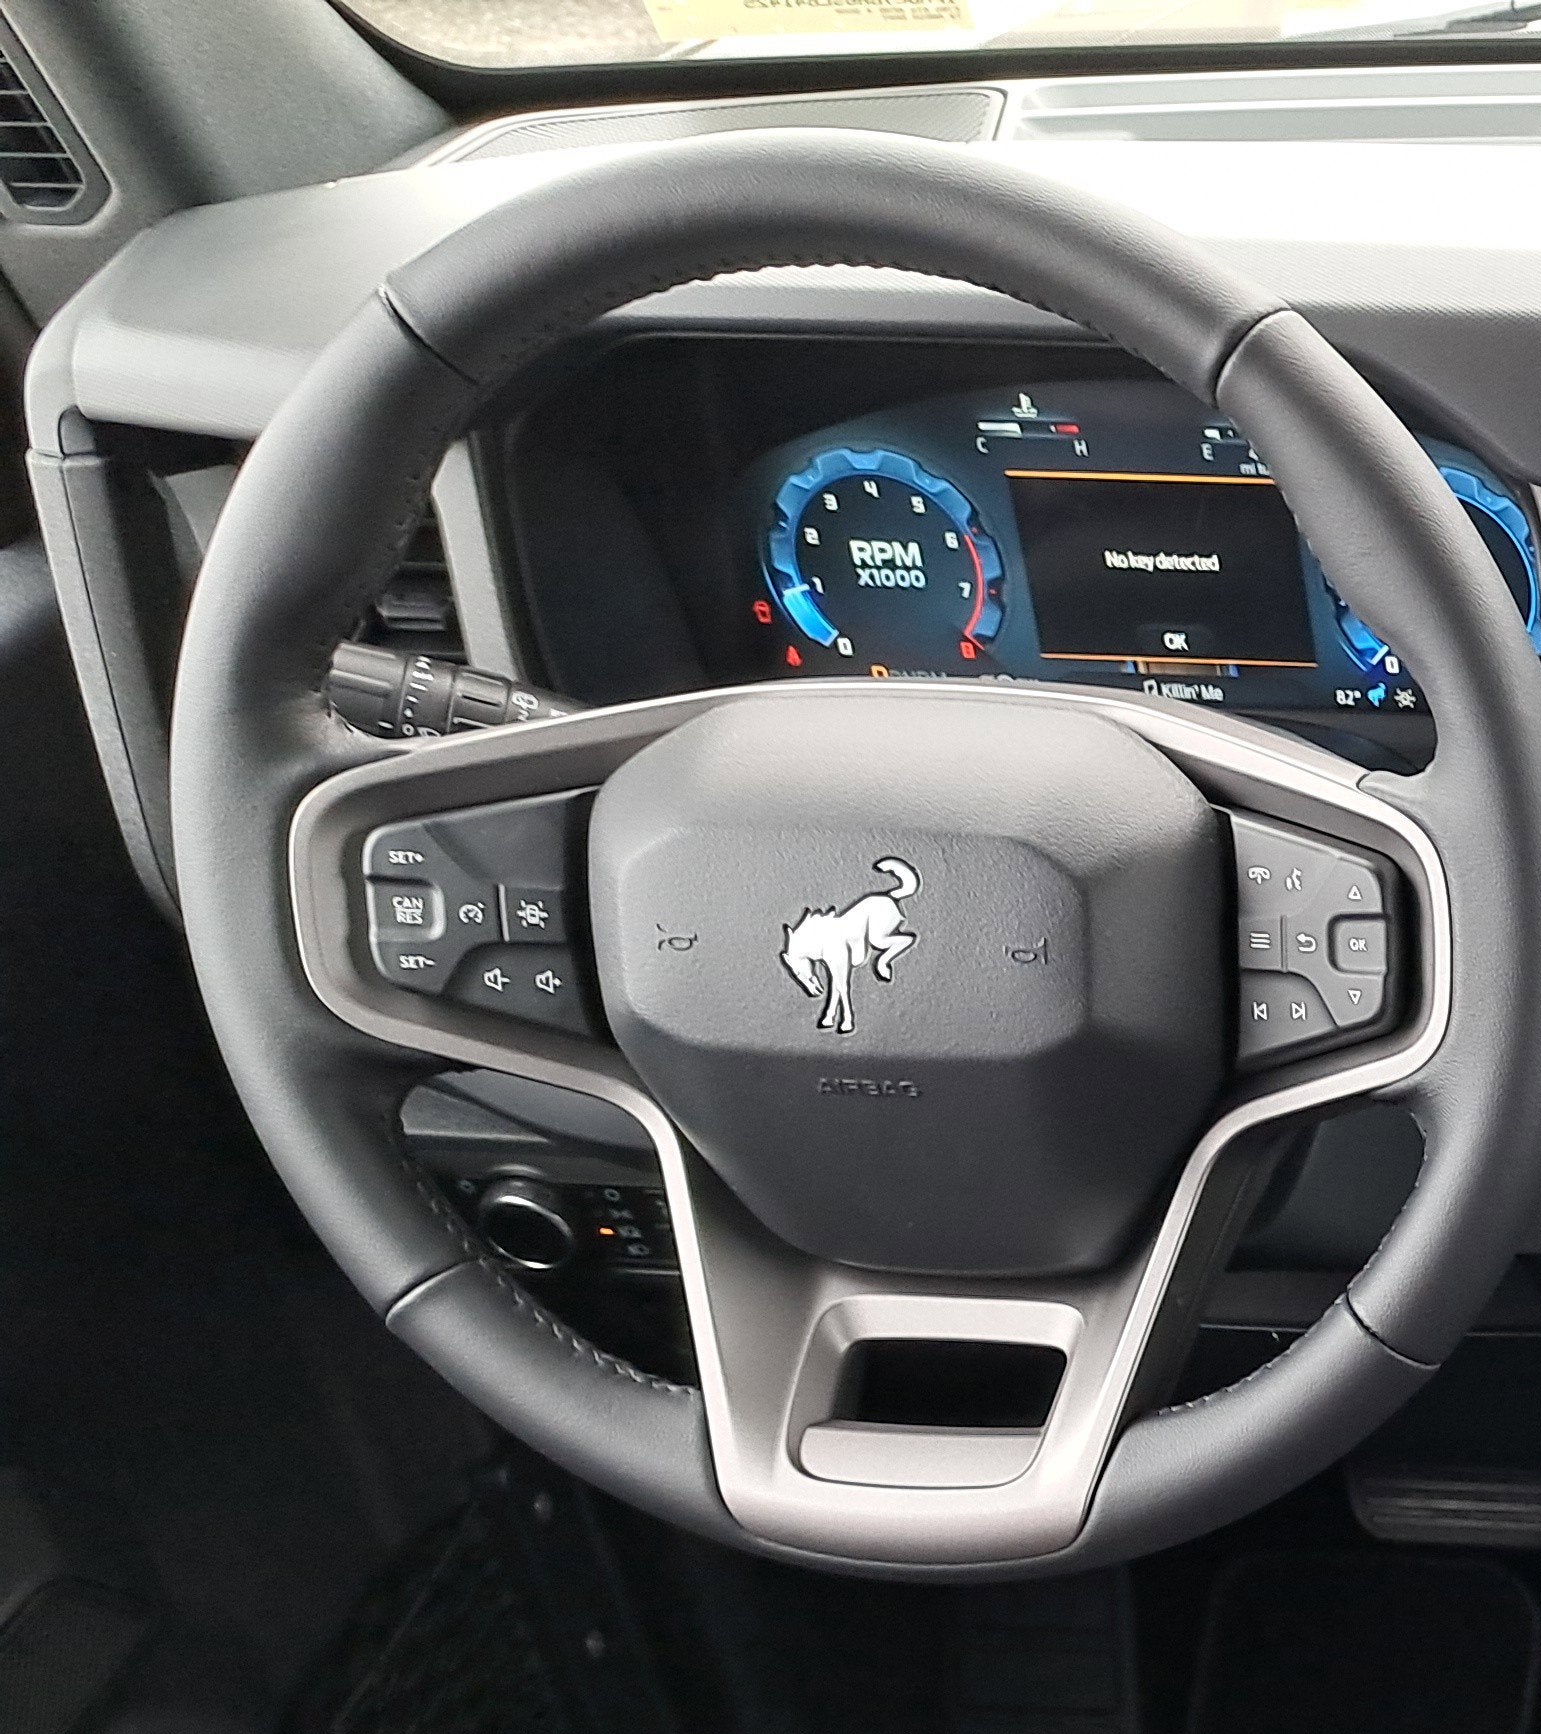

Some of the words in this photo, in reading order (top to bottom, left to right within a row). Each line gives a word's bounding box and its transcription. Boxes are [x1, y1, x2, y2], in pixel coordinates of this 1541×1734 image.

[976, 436, 989, 454] C
[1073, 439, 1089, 457] H
[1201, 443, 1214, 461] E
[862, 480, 880, 498] 4
[822, 493, 839, 511] 3
[910, 496, 926, 514] 5
[804, 527, 821, 545] 2
[944, 531, 960, 549] 6
[849, 539, 923, 568] RPM
[1104, 550, 1129, 568] No
[1127, 551, 1154, 572] key
[1155, 551, 1220, 572] detected
[812, 576, 825, 594] 1
[855, 568, 927, 588] X1000
[958, 581, 972, 598] 7
[1163, 631, 1189, 651] OK
[1201, 685, 1224, 702] Me
[392, 896, 423, 910] CAN
[397, 911, 423, 924] RES
[1350, 938, 1367, 952] OK
[816, 1076, 922, 1098] AIRBAG
